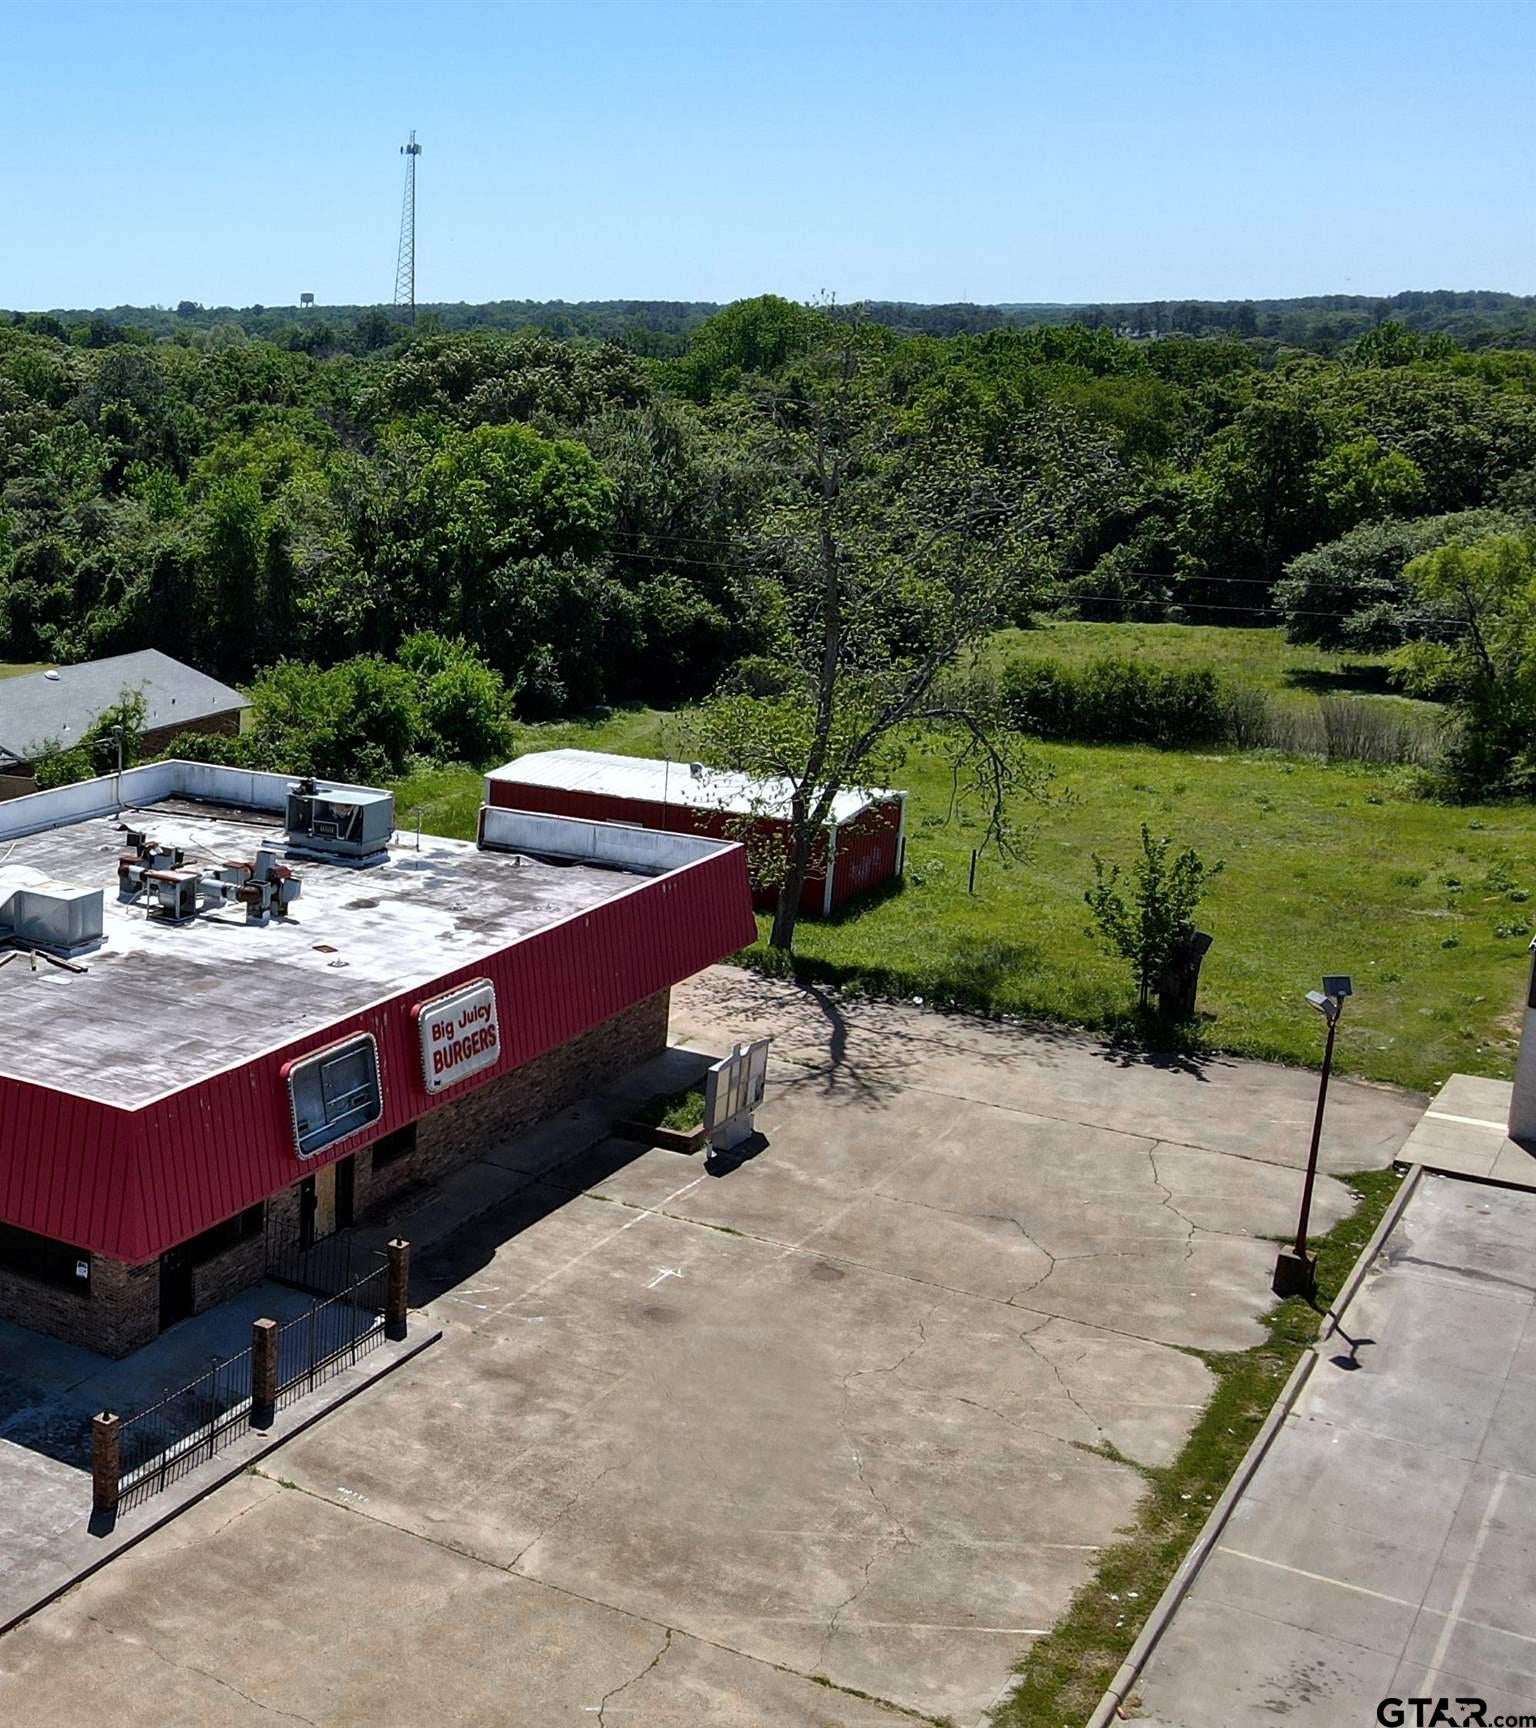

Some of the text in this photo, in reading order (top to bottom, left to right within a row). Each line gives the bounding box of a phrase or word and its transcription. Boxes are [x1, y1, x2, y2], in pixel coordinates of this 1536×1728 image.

[432, 1003, 491, 1041] Big Juicy
[433, 1024, 497, 1074] BURGERS
